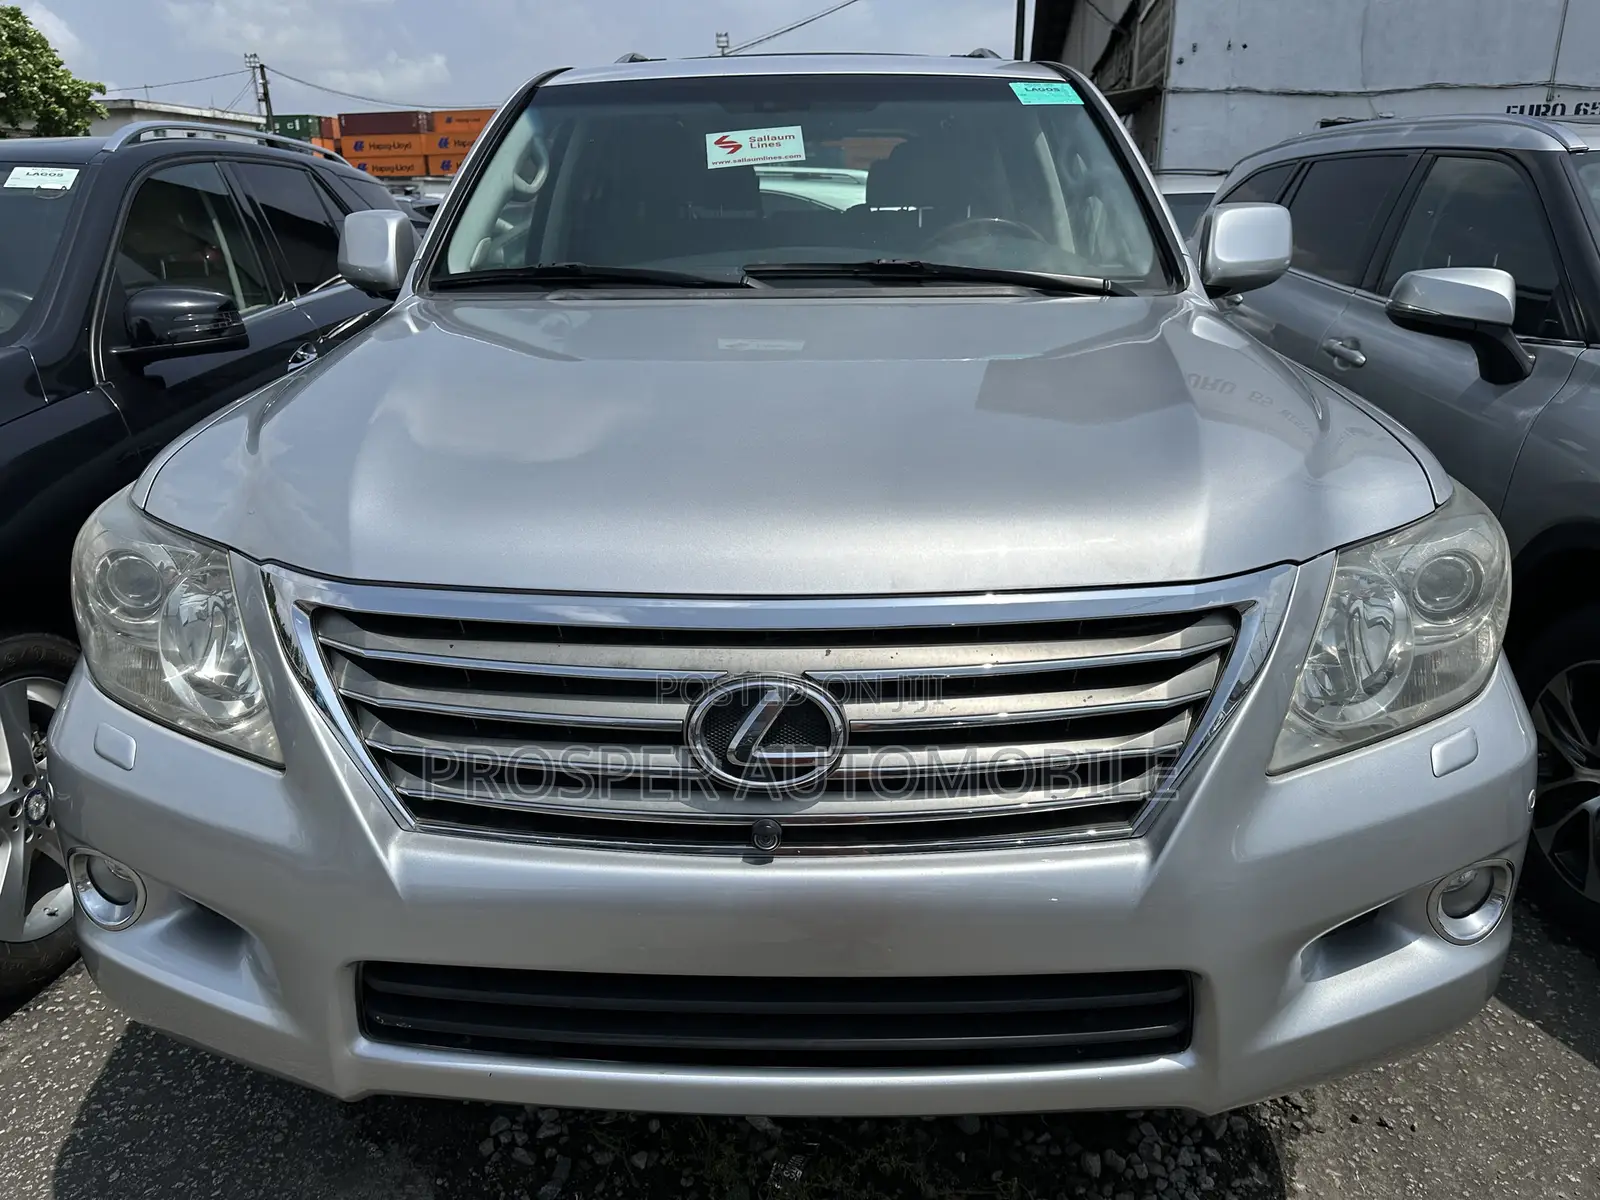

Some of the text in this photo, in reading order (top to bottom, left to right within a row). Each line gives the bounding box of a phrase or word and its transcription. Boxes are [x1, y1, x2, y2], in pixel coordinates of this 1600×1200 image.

[1506, 103, 1566, 116] EURO
[749, 134, 795, 143] Sallaum
[750, 141, 781, 149] Lines
[712, 154, 801, 165] www.sallaumlines.com
